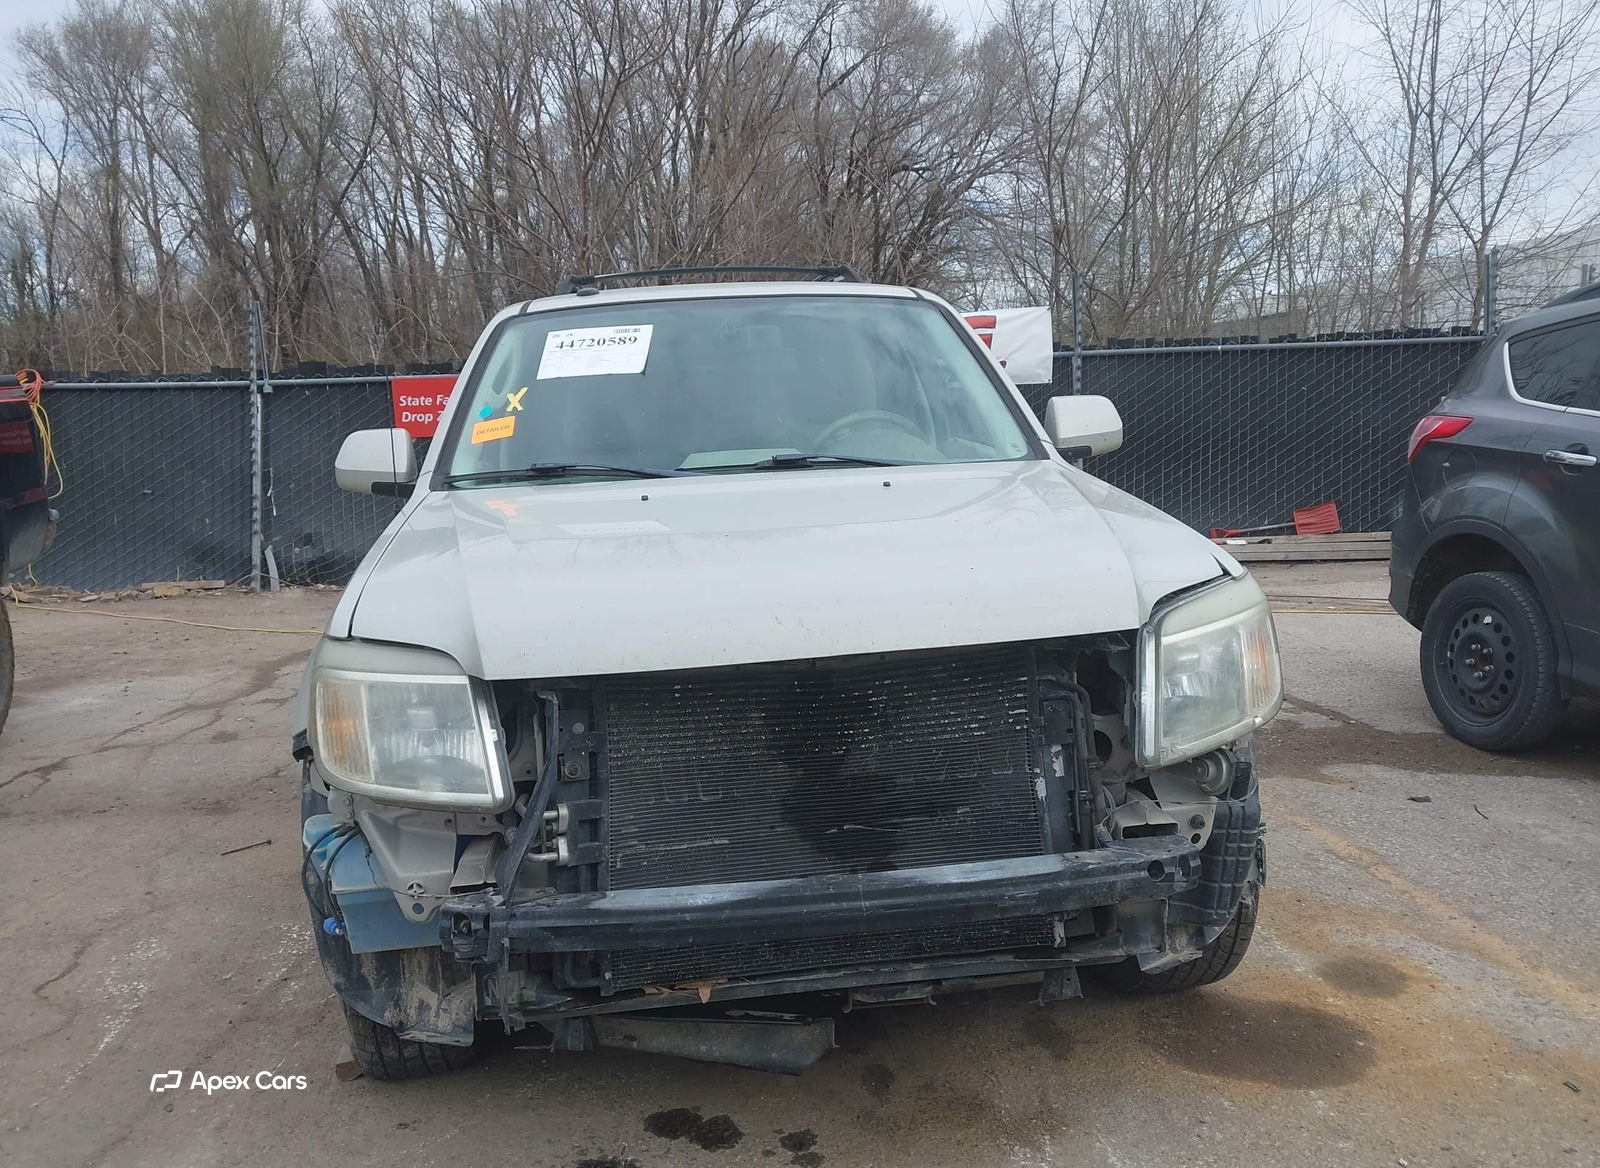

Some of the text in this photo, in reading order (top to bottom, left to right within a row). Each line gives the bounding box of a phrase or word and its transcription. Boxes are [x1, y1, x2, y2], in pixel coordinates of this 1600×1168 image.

[555, 335, 638, 350] 44720589
[399, 395, 433, 406] State
[402, 411, 433, 424] Drop
[476, 424, 510, 436] DETAILED
